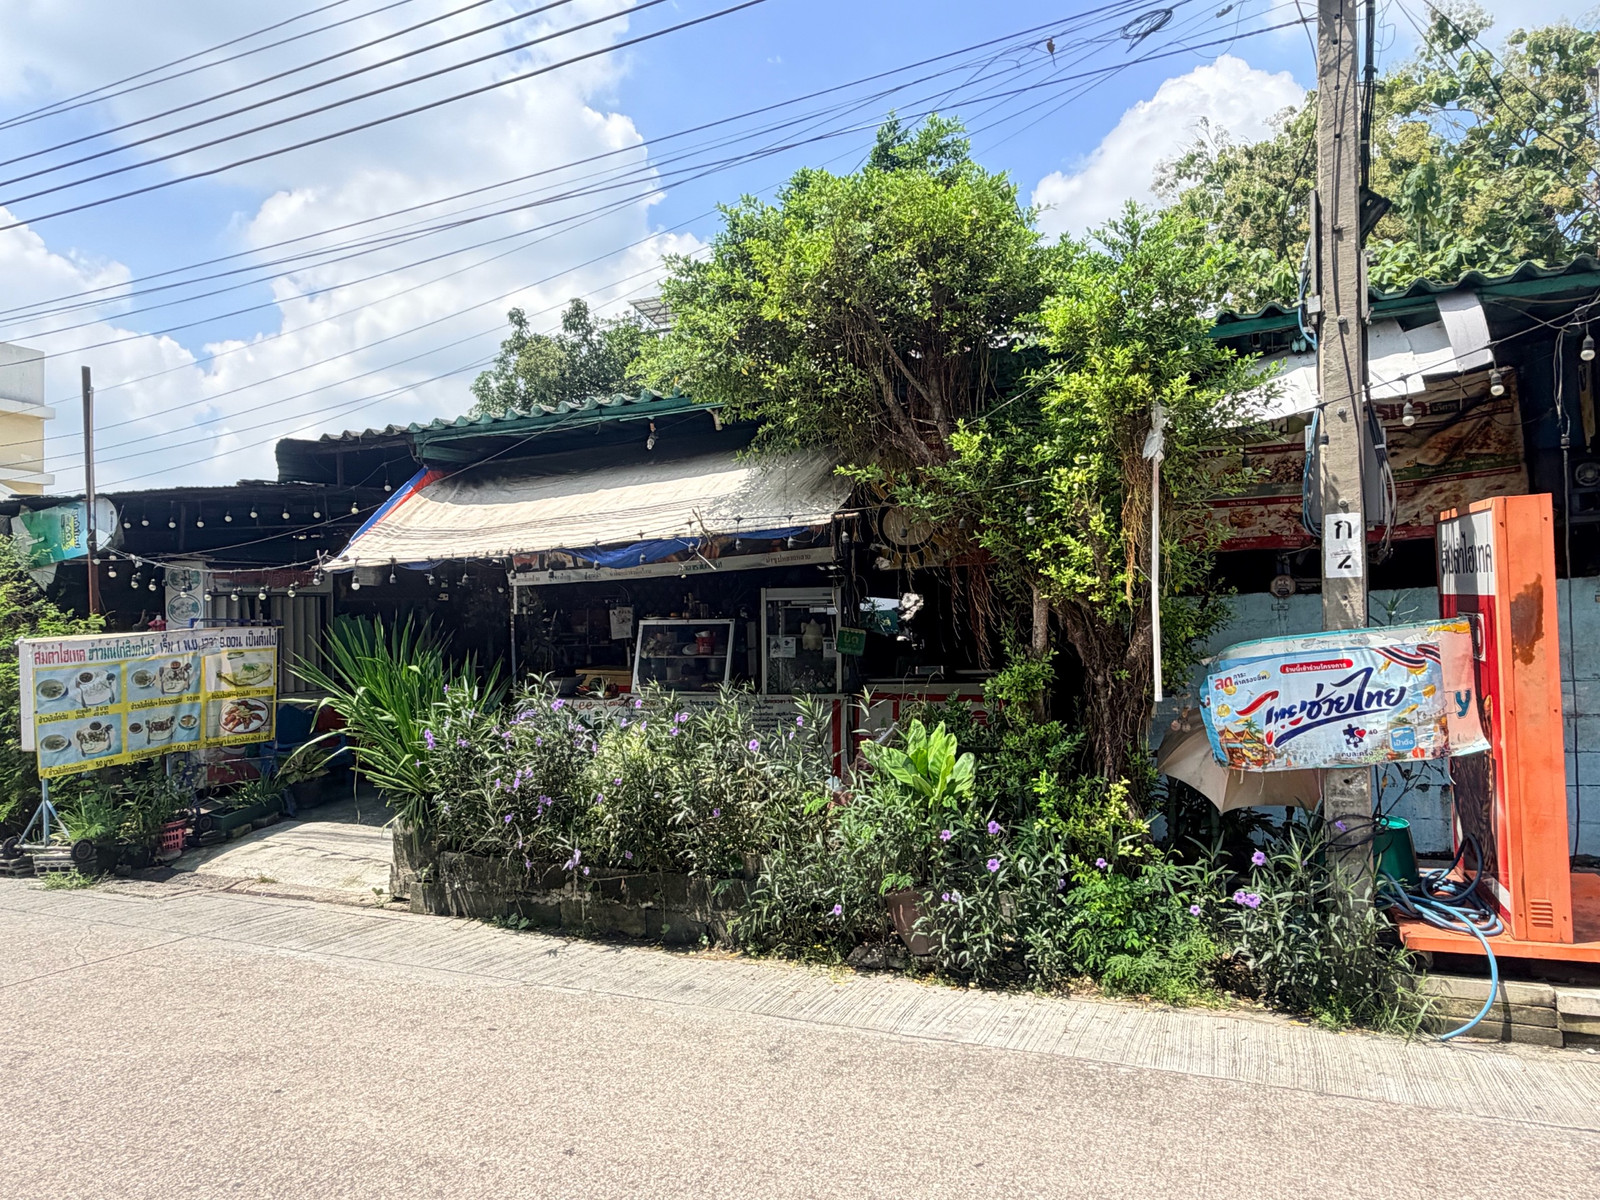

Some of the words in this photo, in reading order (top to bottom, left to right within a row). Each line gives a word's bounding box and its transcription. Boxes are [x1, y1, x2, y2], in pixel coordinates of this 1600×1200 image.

[1334, 520, 1353, 540] ก
[1337, 554, 1353, 570] 2
[1284, 662, 1348, 674] ร้านนี้เข้าร่วมโครงการ
[1233, 671, 1247, 681] ภาระ
[1213, 677, 1234, 691] ลด
